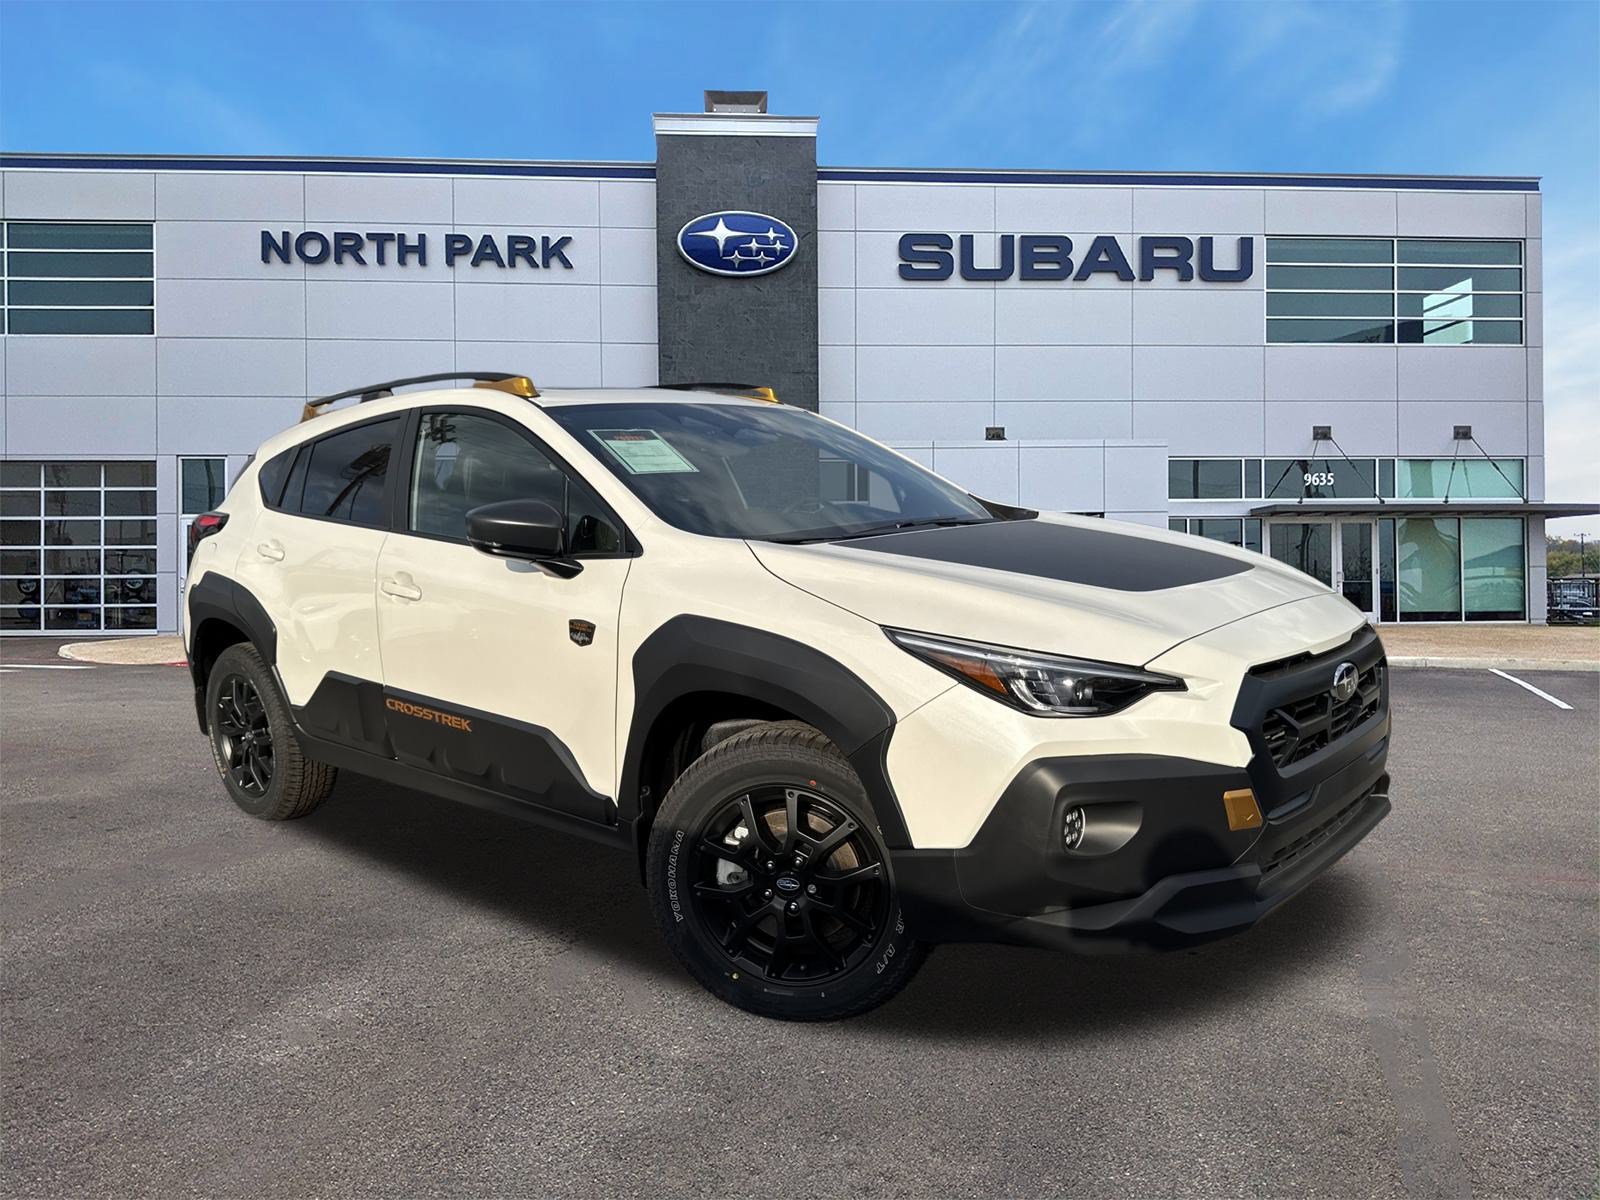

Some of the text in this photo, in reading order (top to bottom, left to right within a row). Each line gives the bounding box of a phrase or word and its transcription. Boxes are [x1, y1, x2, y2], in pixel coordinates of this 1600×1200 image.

[260, 230, 573, 268] NORTH PARK
[898, 233, 1254, 281] SUBARU
[1303, 472, 1335, 486] 9635
[385, 698, 472, 731] CROSSTREK
[667, 830, 684, 922] YOKOHAMA
